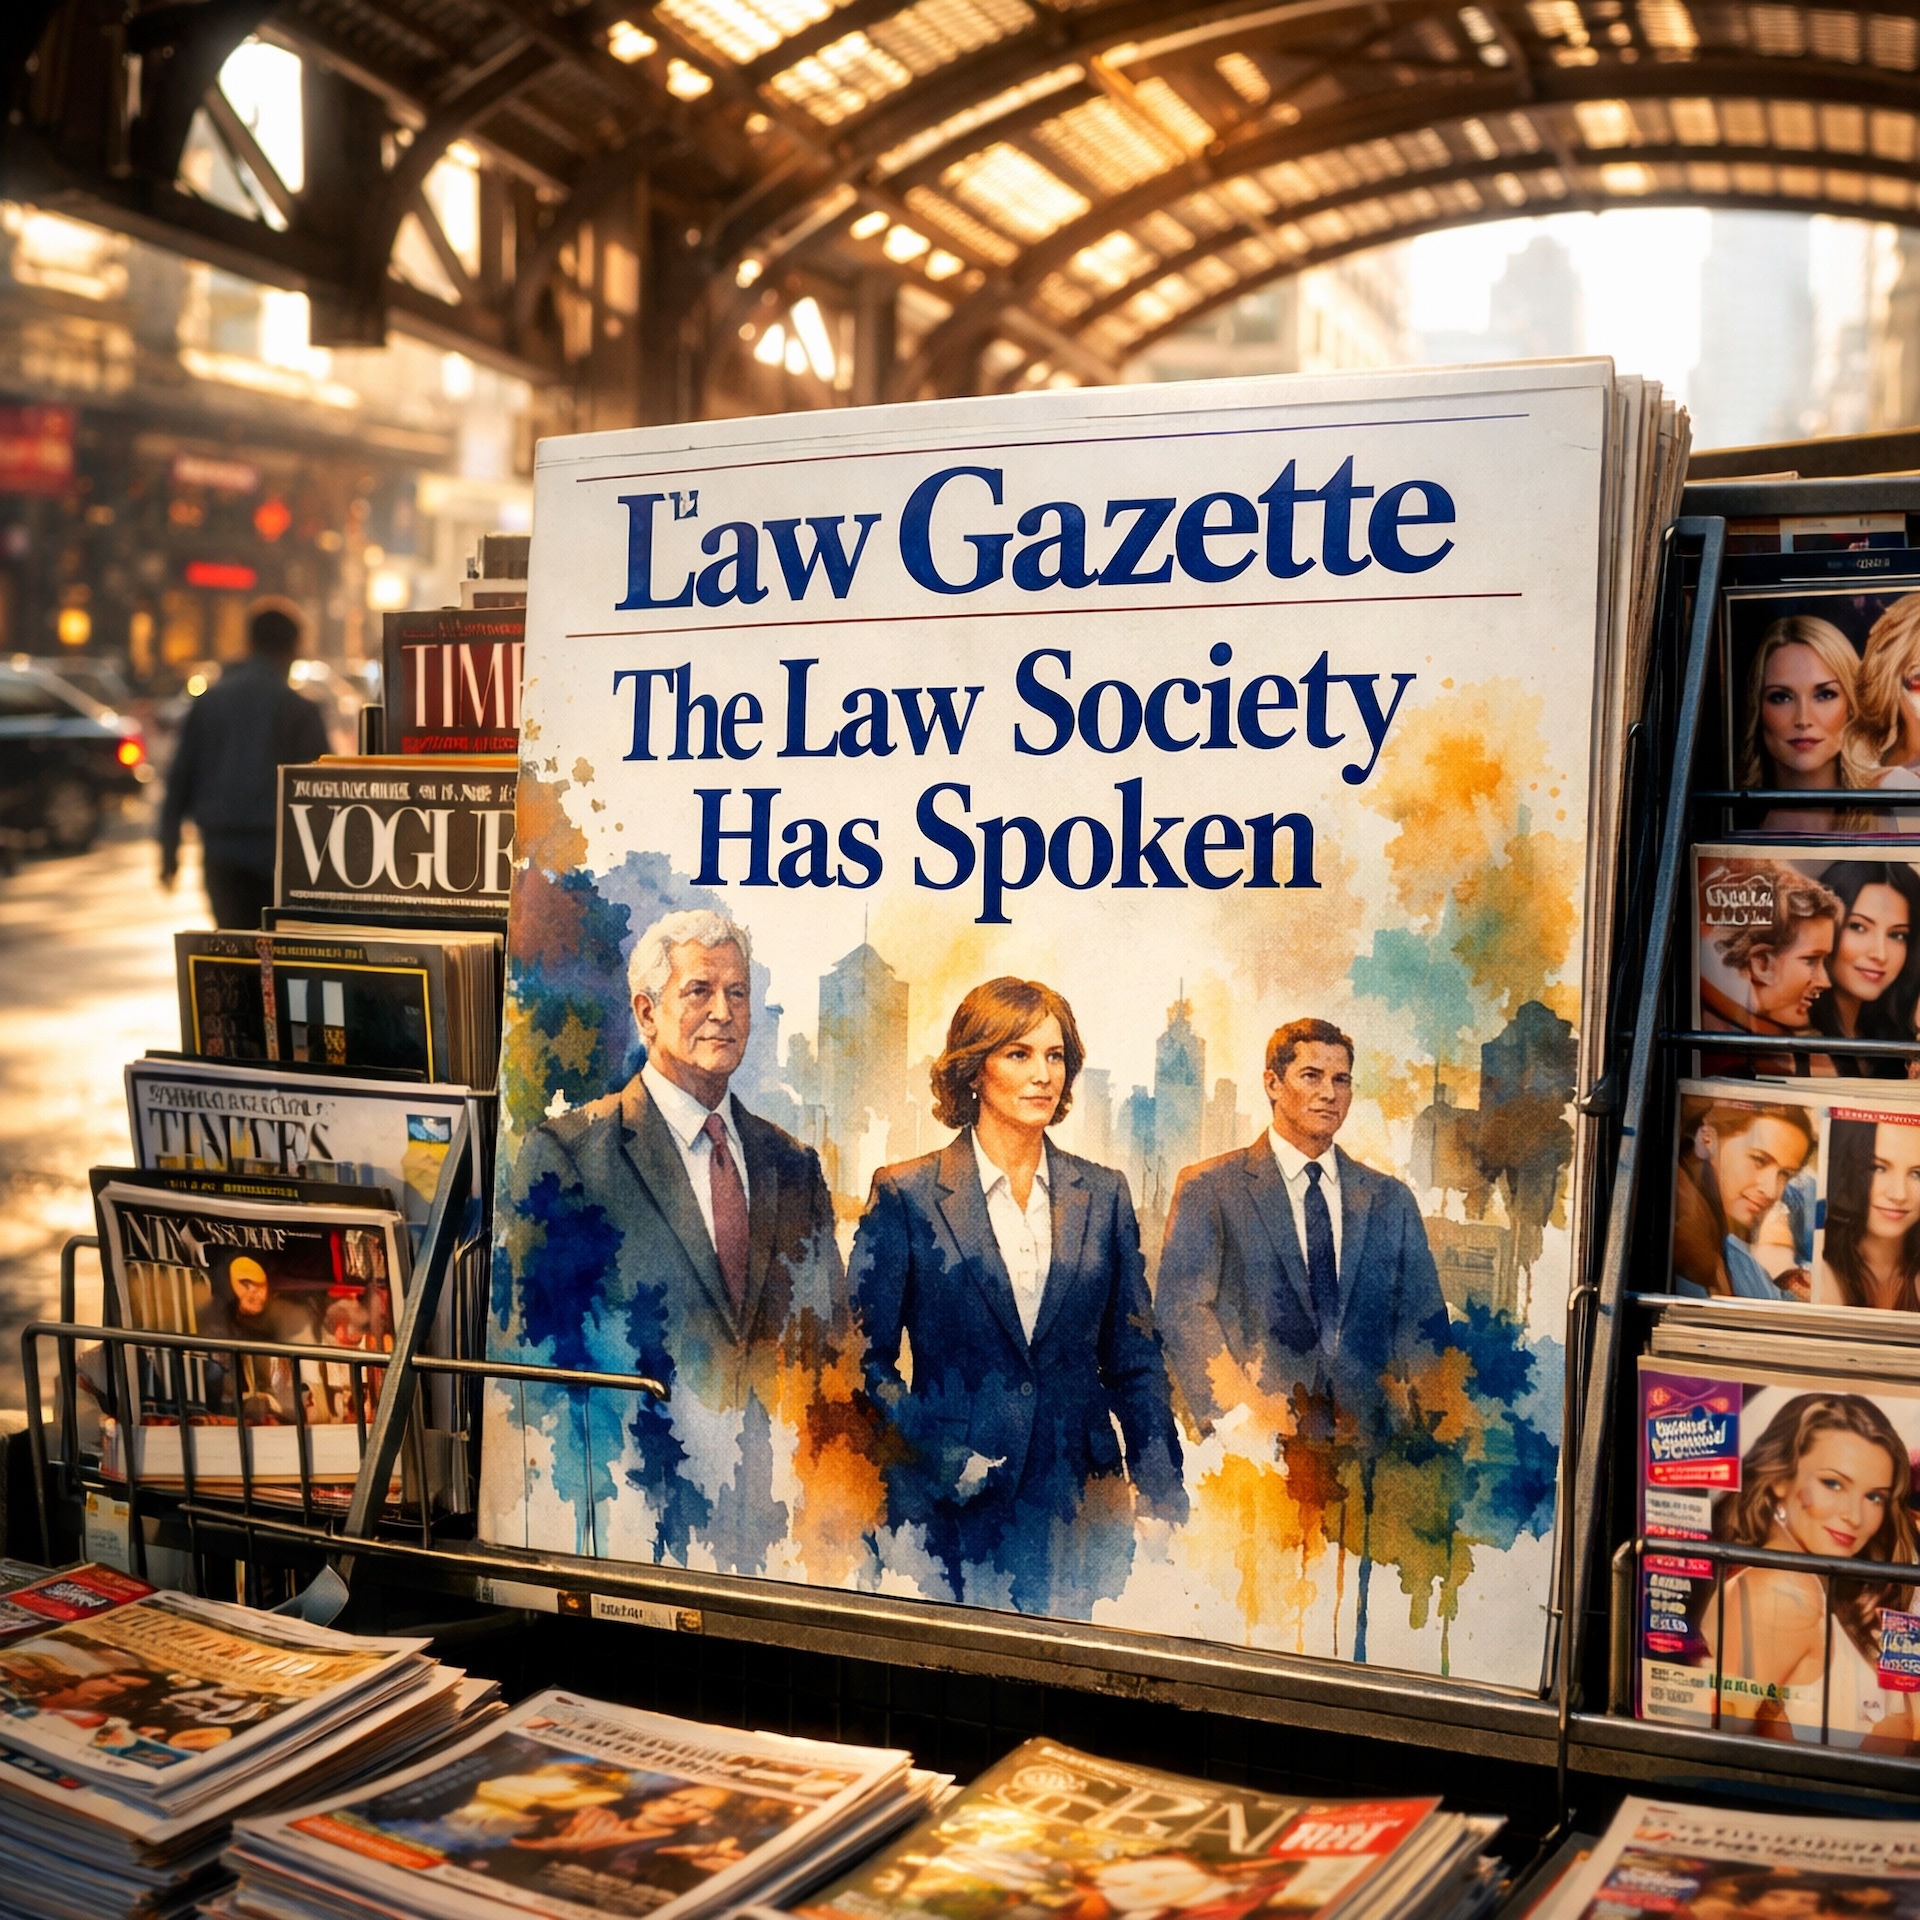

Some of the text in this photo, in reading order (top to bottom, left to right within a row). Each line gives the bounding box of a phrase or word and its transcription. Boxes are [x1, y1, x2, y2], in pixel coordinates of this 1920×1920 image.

[614, 456, 1456, 611] Law Gazette
[613, 642, 1416, 785] The Law Society
[288, 803, 516, 894] VOGUE
[689, 777, 1321, 925] Has Spoken
